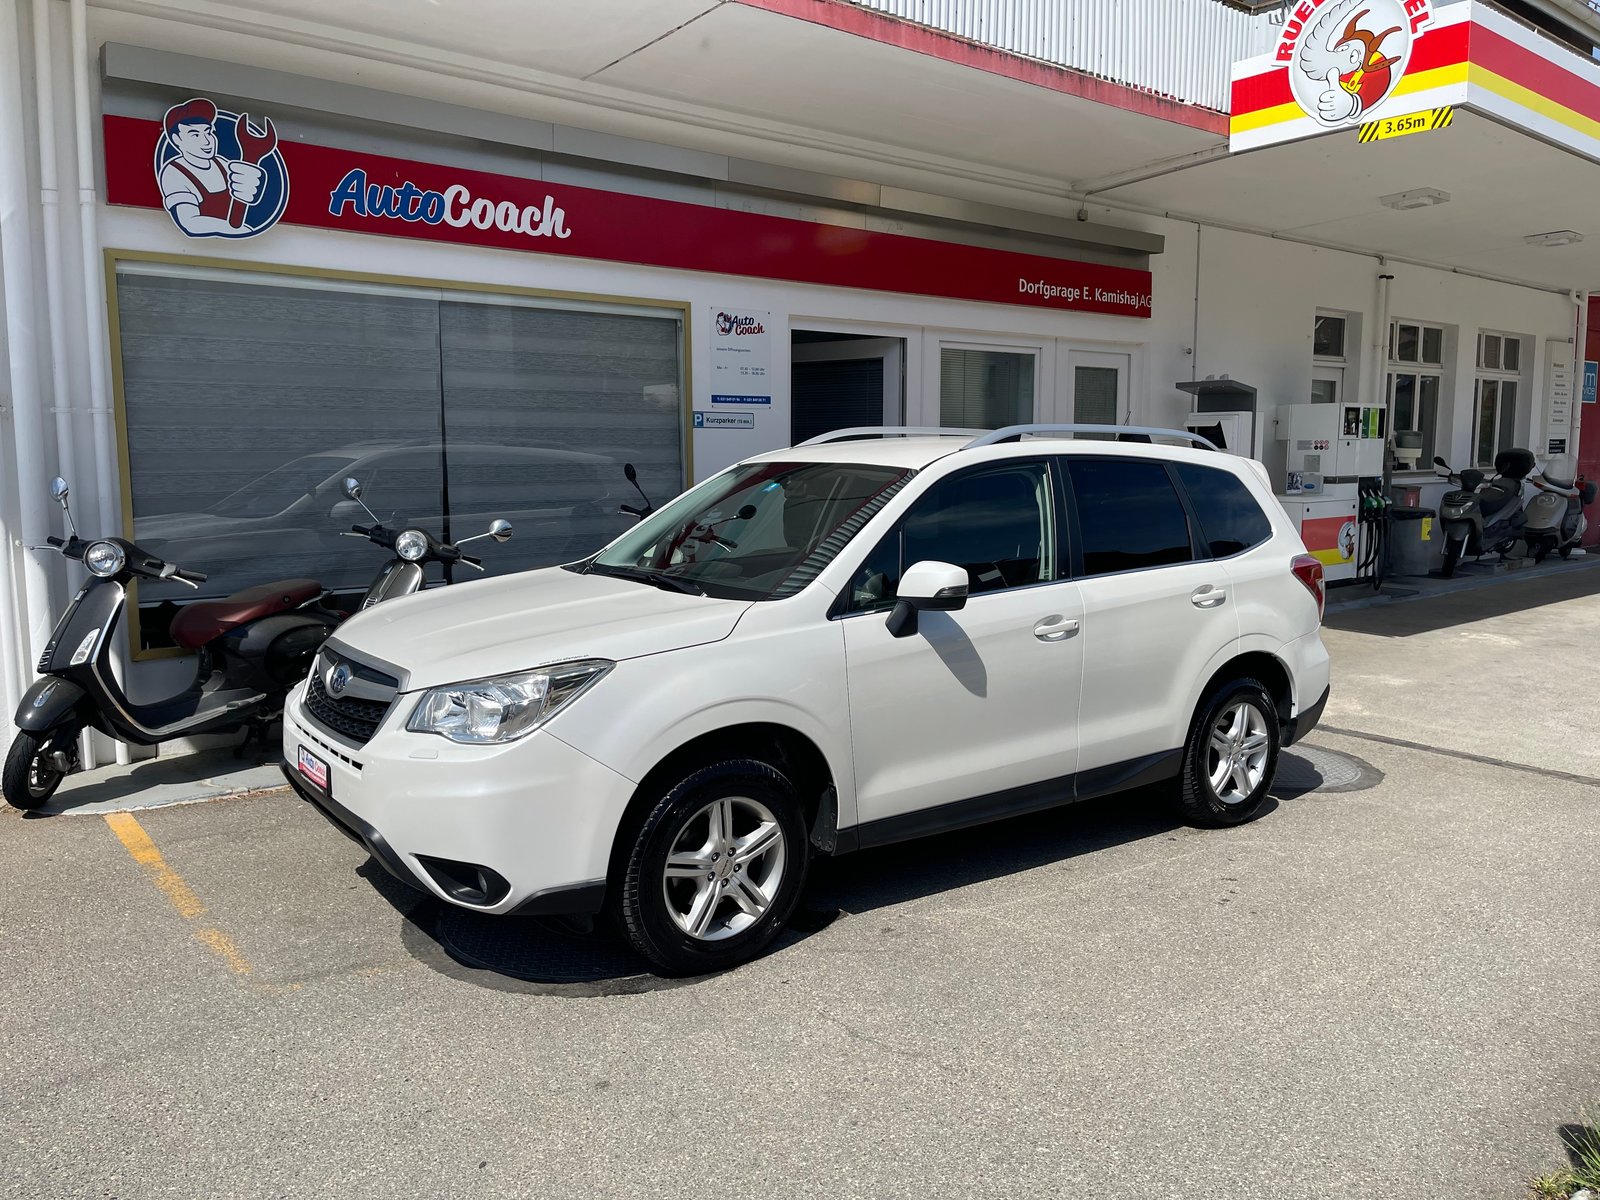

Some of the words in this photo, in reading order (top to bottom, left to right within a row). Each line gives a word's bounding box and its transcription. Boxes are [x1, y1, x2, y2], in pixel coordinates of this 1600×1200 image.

[1276, 0, 1325, 61] RUE
[1402, 0, 1430, 34] EL
[1385, 117, 1425, 134] 3.65m
[328, 168, 572, 239] AutoCoach
[1019, 278, 1080, 302] Dorfgarage
[1083, 286, 1092, 300] E.
[1095, 288, 1139, 309] Kamishaj
[732, 315, 755, 327] Auto
[735, 322, 765, 336] Coach
[706, 416, 736, 425] Kurzparker
